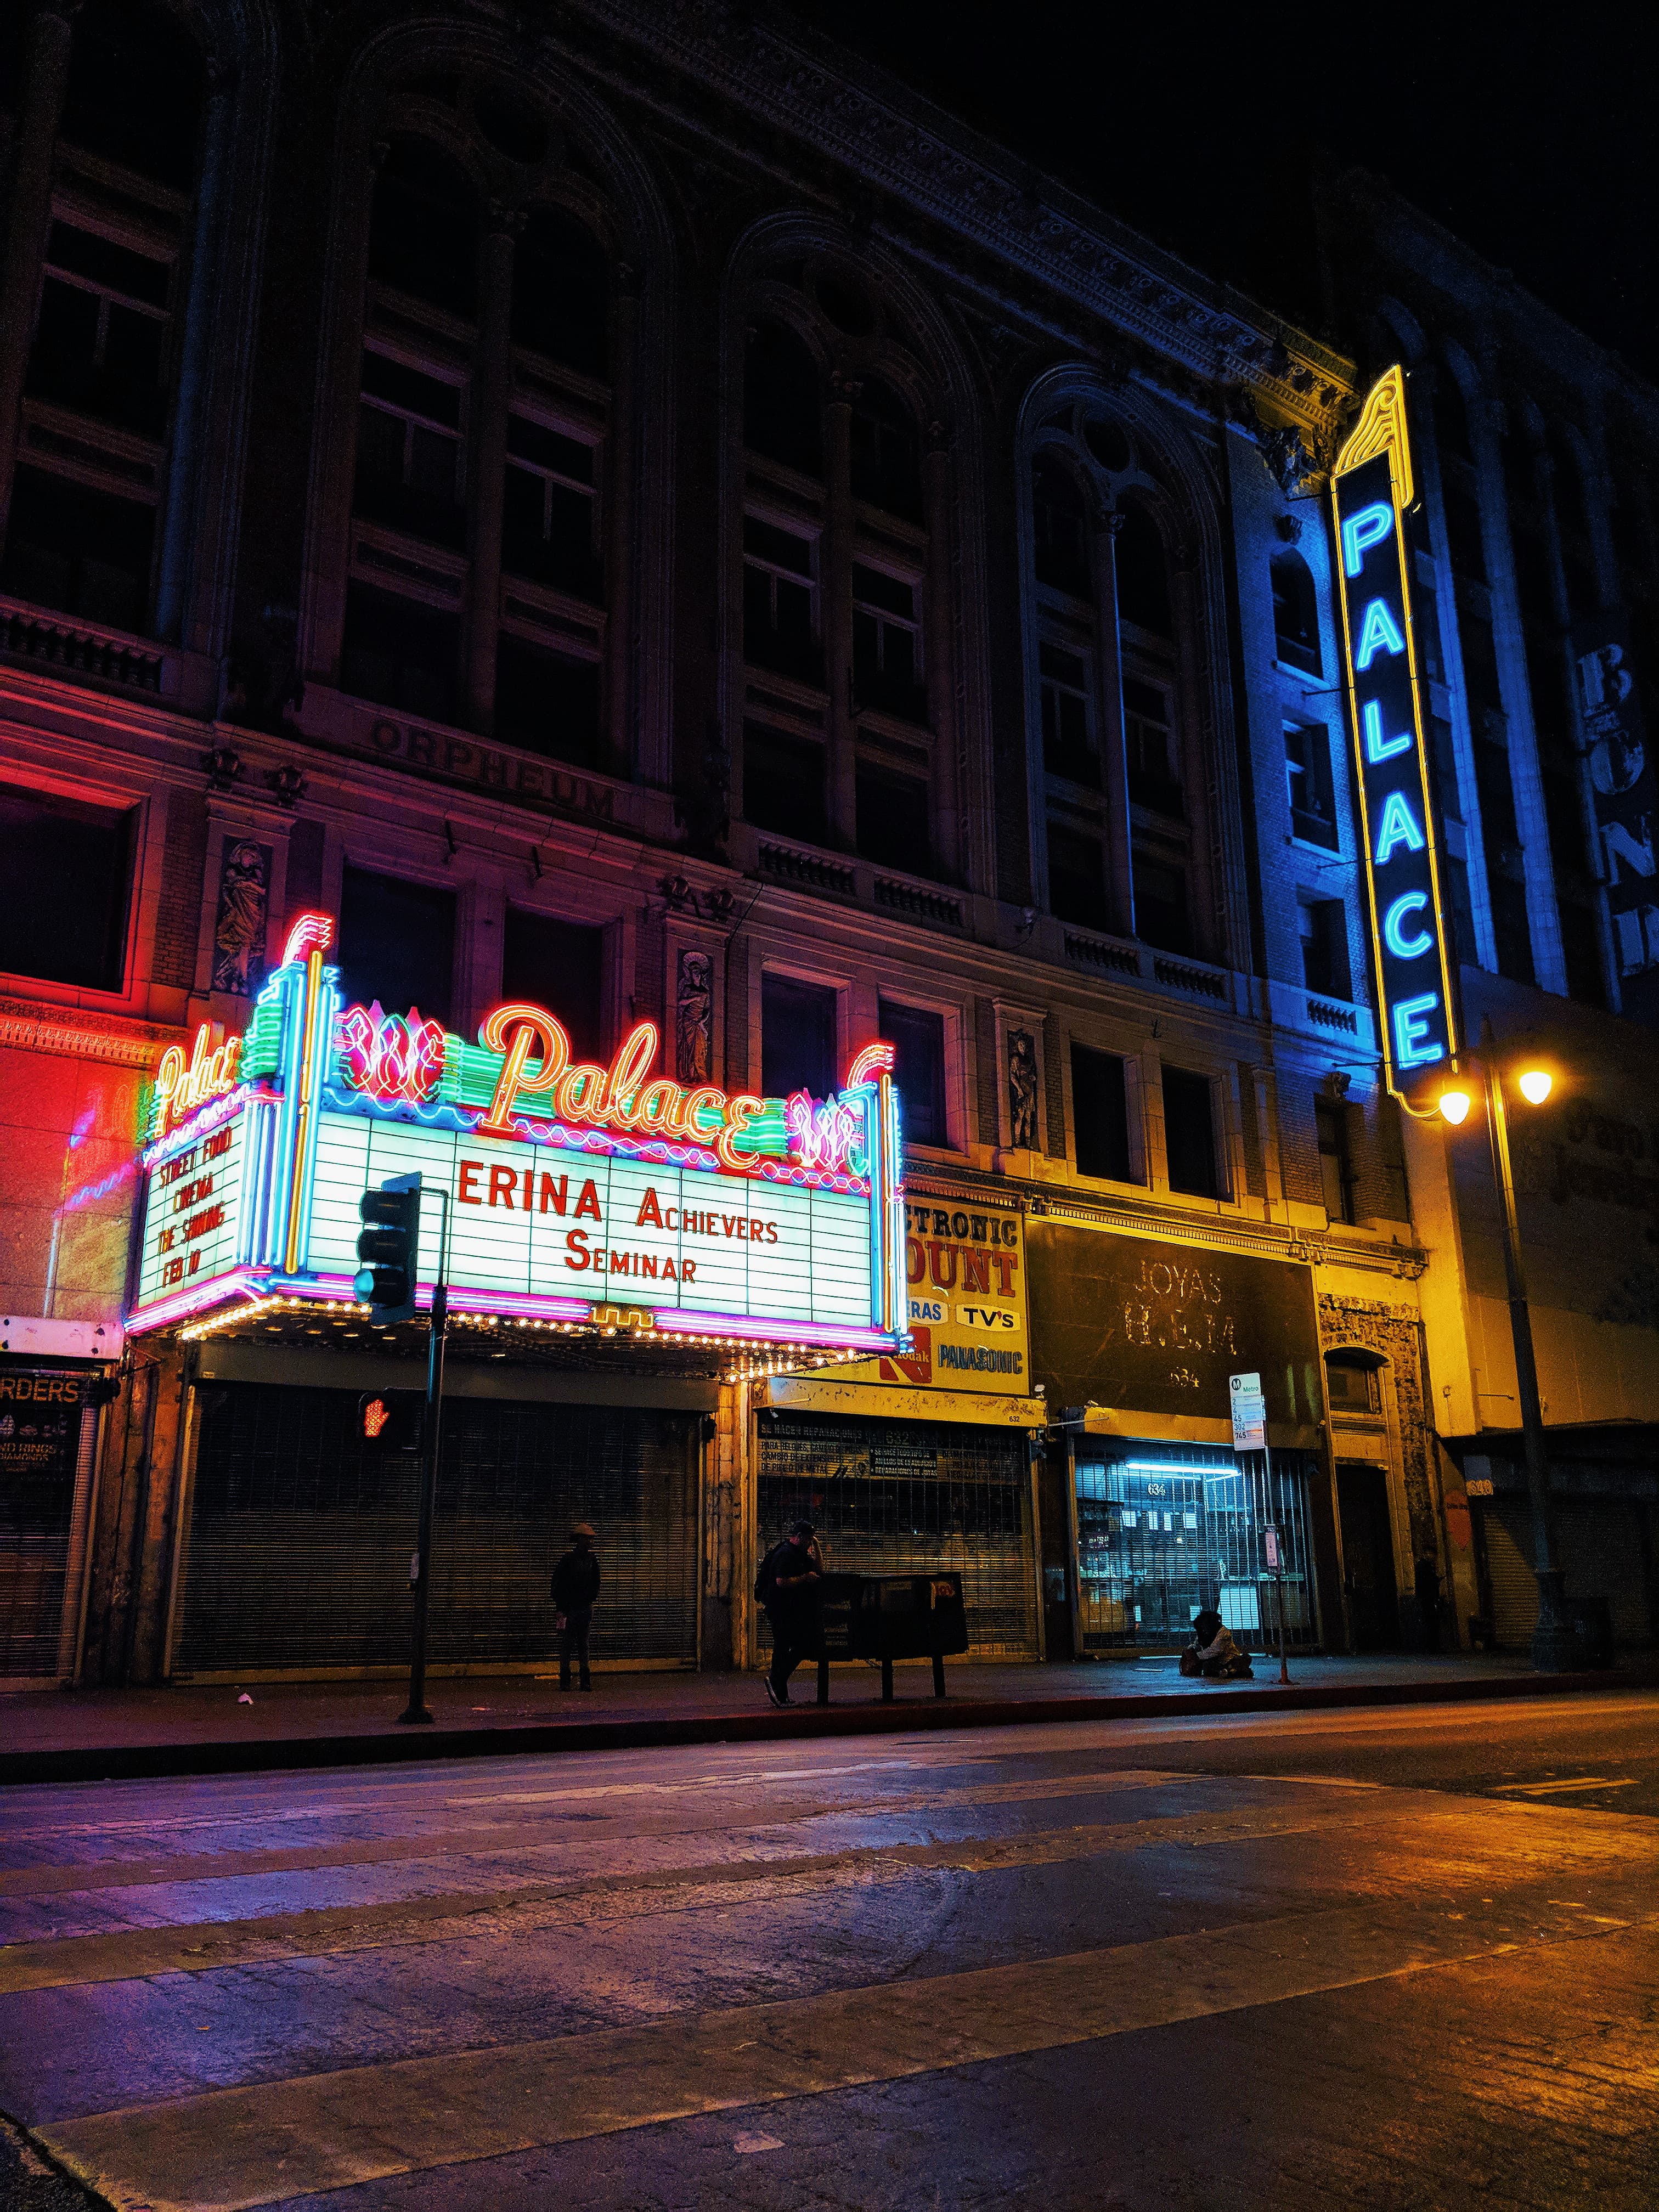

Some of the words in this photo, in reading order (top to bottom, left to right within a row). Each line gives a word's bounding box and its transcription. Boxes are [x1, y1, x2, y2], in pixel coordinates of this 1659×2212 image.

[372, 719, 615, 816] ORPHEUM
[1342, 501, 1444, 1069] PALACE
[482, 1003, 766, 1170] Palace
[159, 1146, 197, 1189] STREET
[173, 1172, 213, 1214] CINEMA
[459, 1160, 602, 1222] ERINA
[159, 1225, 177, 1255] THE
[181, 1201, 225, 1243] SHINING
[162, 1257, 183, 1288] FEB
[1133, 1261, 1221, 1304] JOYAS
[963, 1307, 1014, 1328] TV'S
[939, 1344, 1023, 1374] PANASONIC
